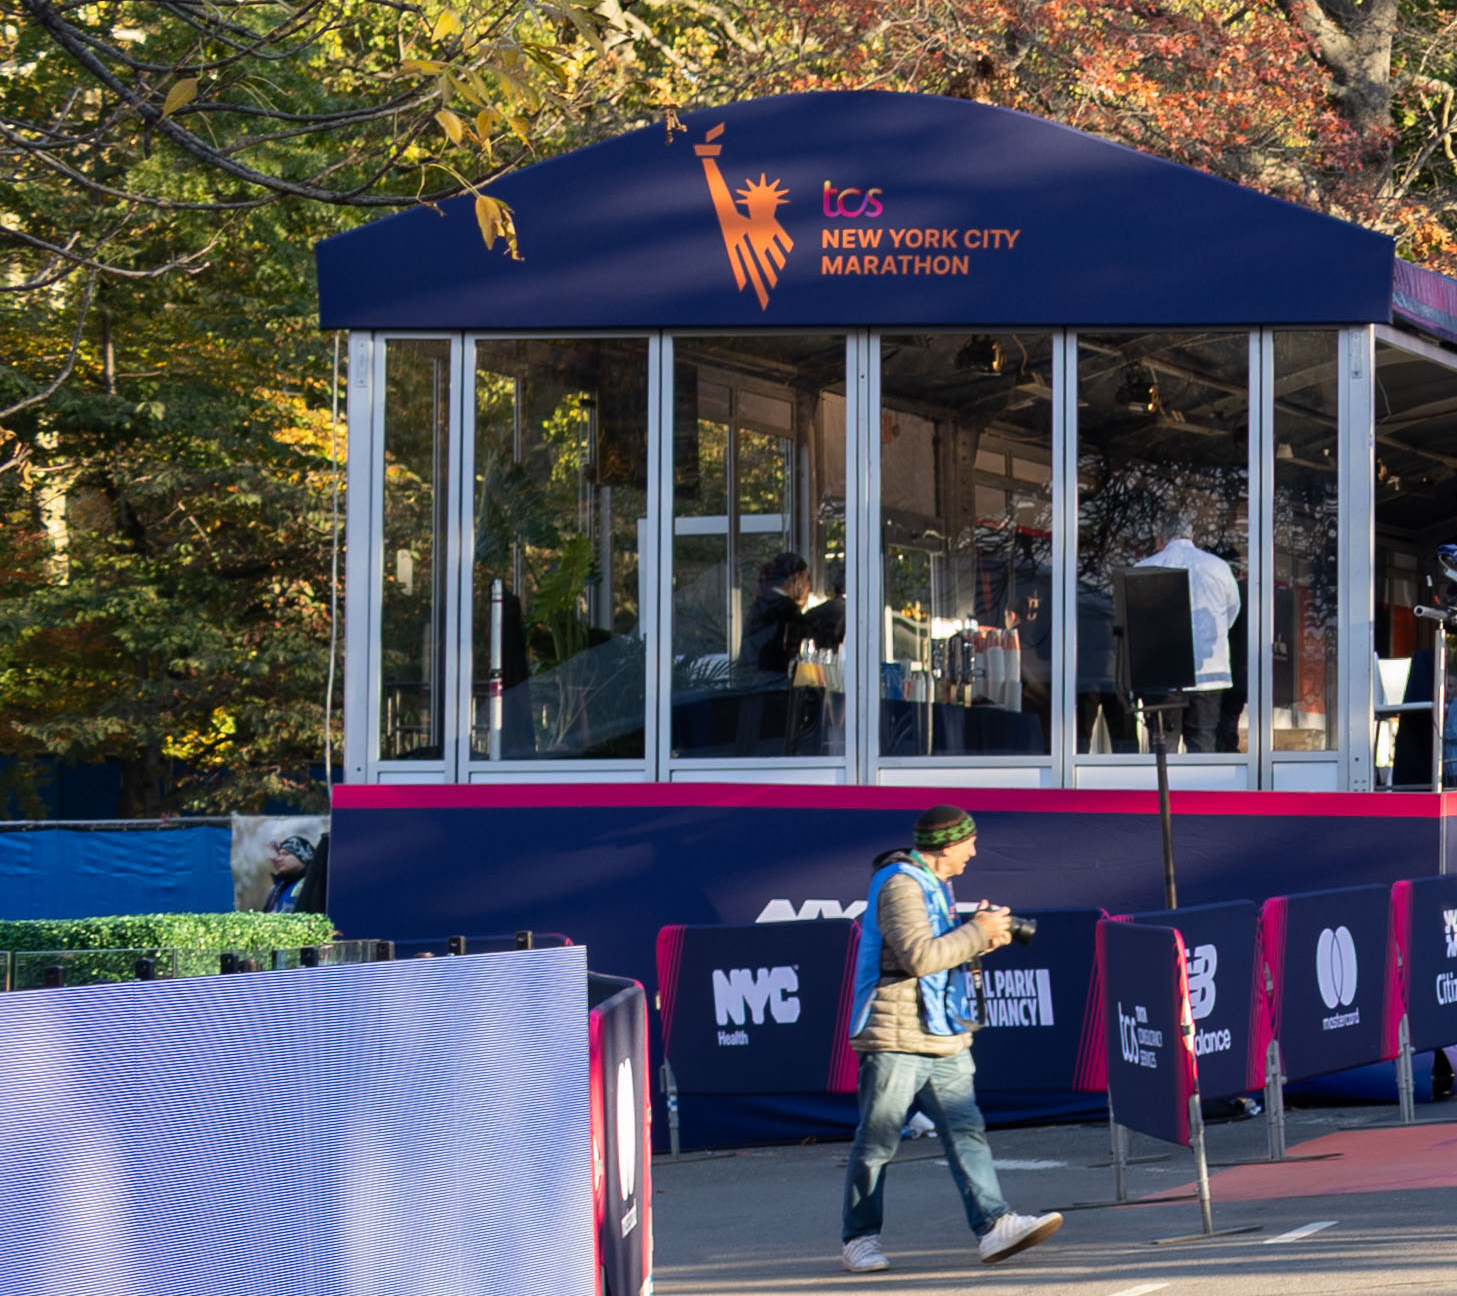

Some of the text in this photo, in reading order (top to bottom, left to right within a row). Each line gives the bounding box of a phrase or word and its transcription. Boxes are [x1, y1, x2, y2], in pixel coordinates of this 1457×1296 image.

[822, 180, 884, 218] tcs
[821, 229, 1020, 251] NEW YORK CITY
[821, 255, 970, 276] MARATHON
[712, 965, 801, 1027] NYC
[994, 969, 1036, 999] PARK
[1117, 1001, 1139, 1064] tcs
[1322, 1008, 1361, 1031] mastercard
[718, 1031, 749, 1046] Health
